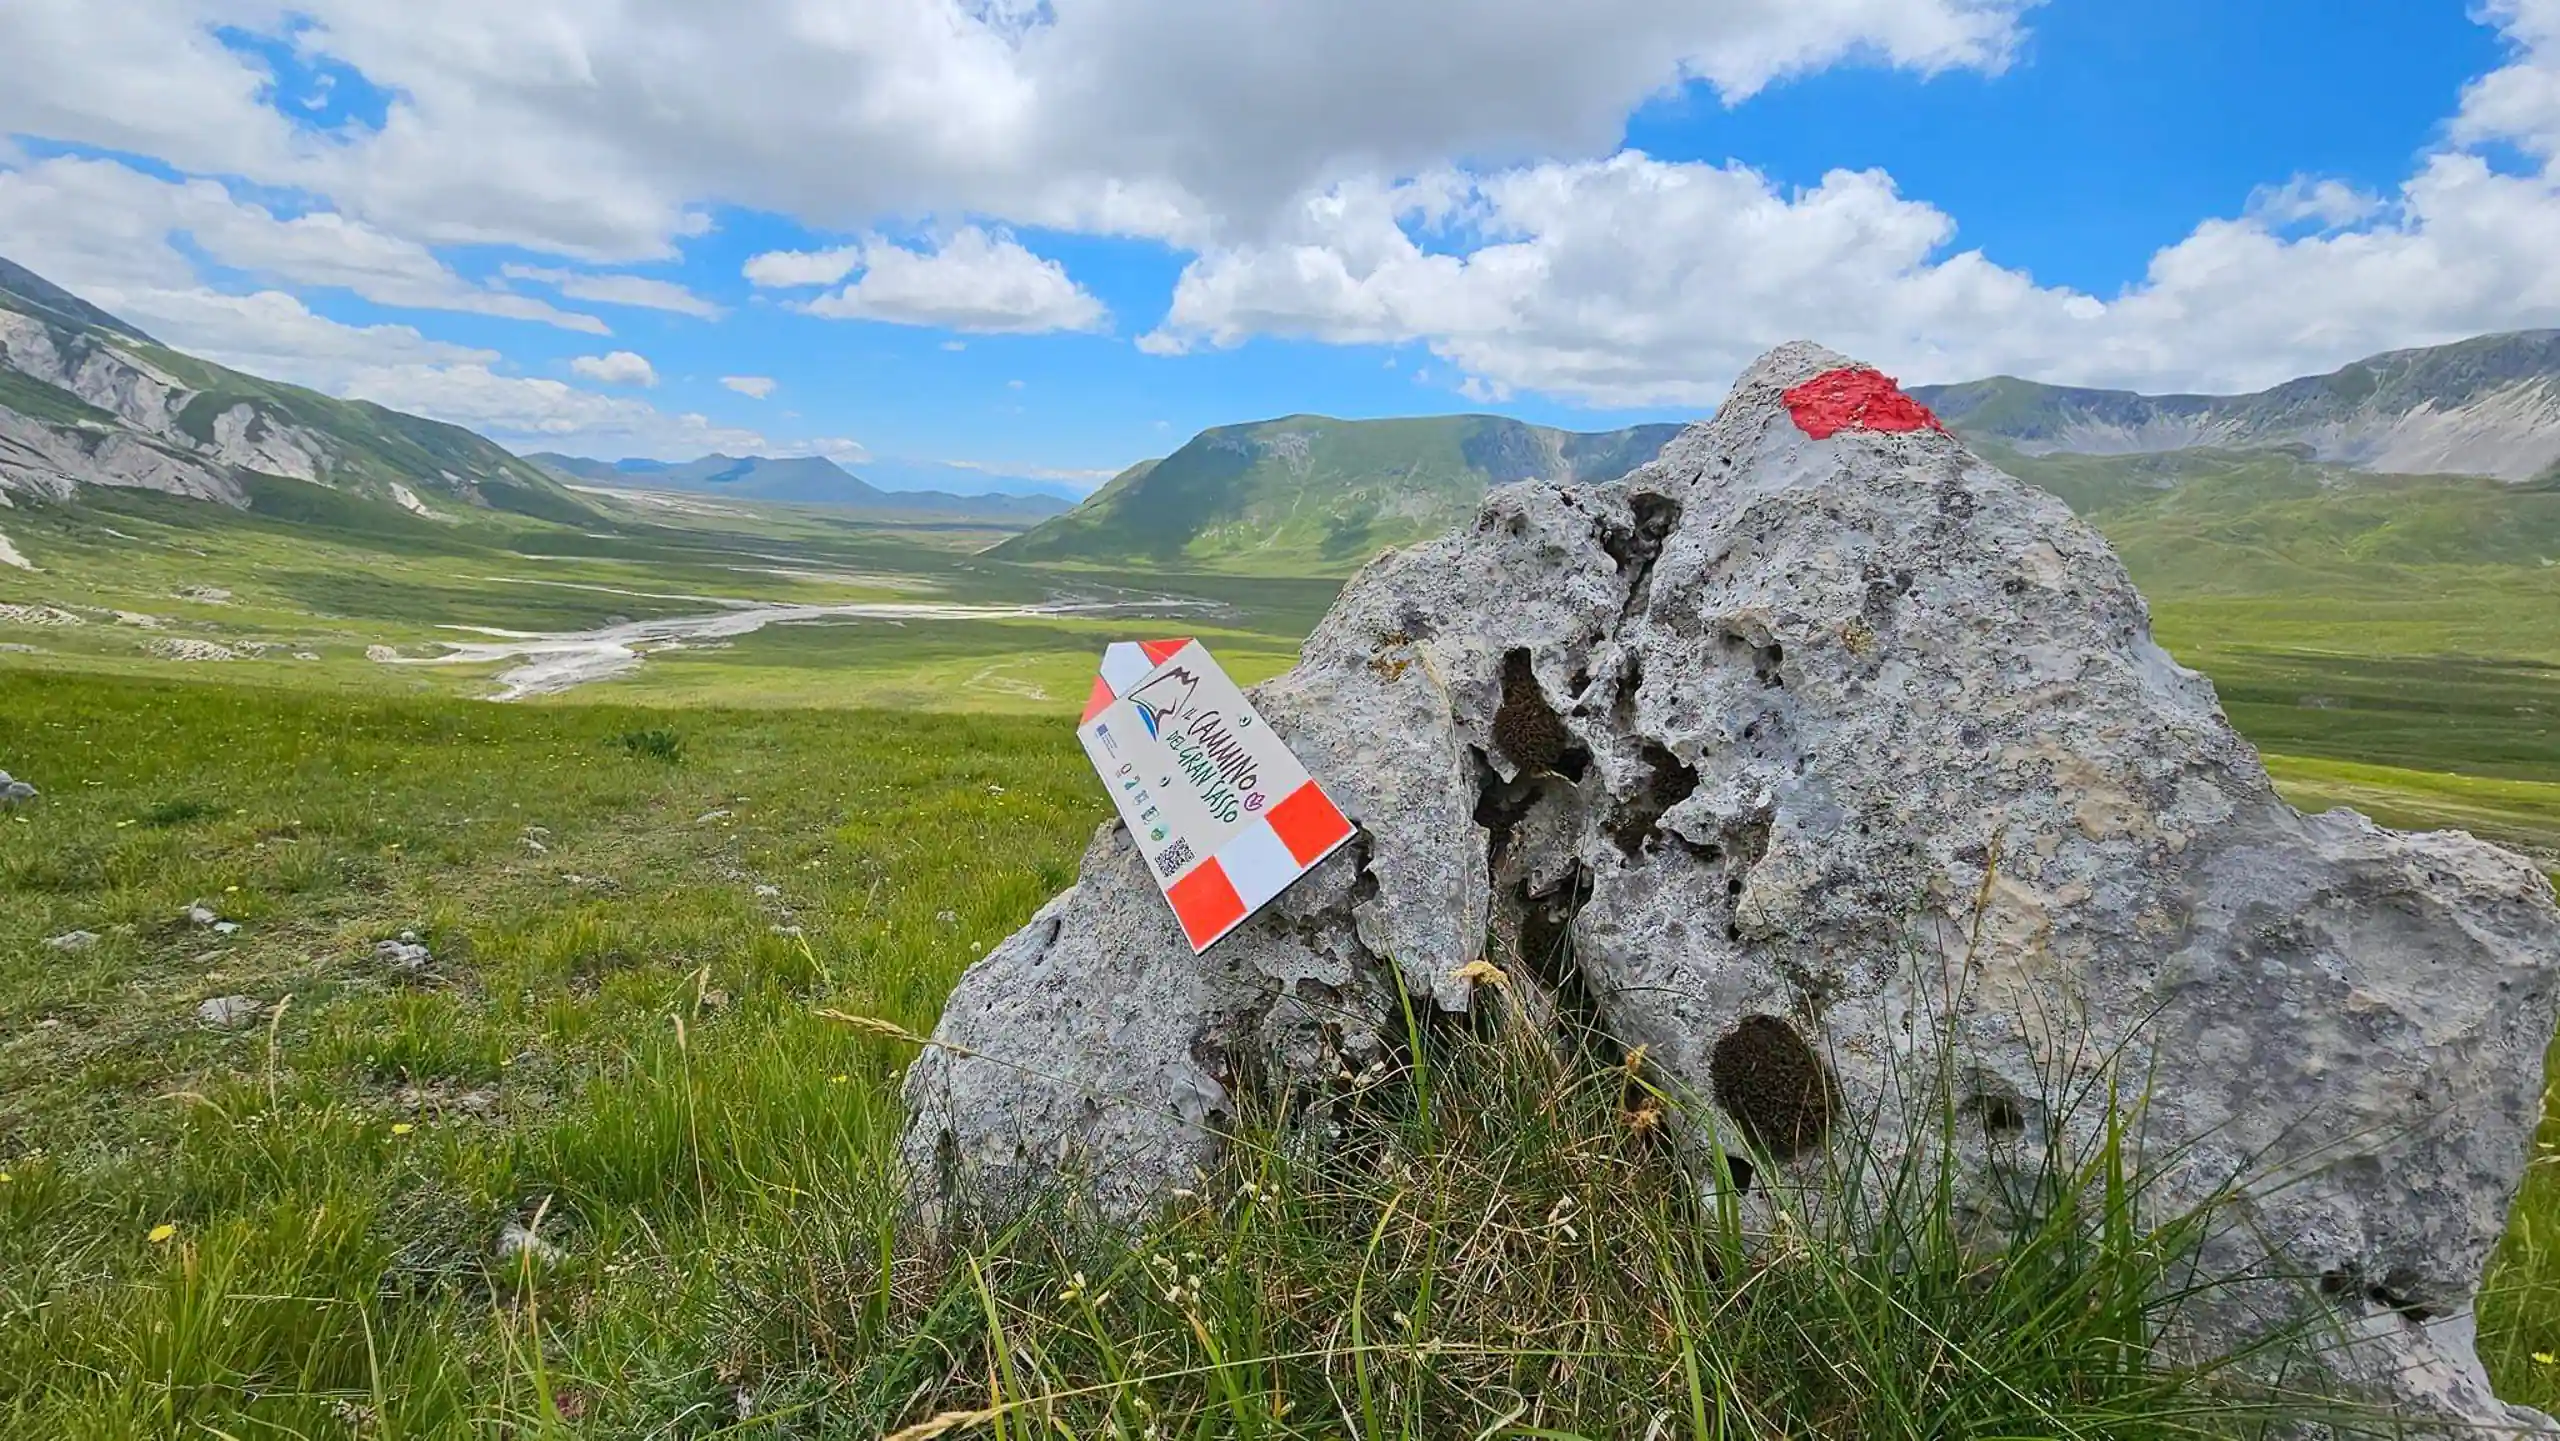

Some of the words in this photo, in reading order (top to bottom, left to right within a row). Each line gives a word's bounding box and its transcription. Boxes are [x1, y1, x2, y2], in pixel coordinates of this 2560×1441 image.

[1181, 707, 1198, 720] IL
[1187, 710, 1258, 790] CAMMINO
[1166, 730, 1186, 750] DEL
[1178, 745, 1217, 787] GRAN
[1200, 780, 1239, 823] SASSO
